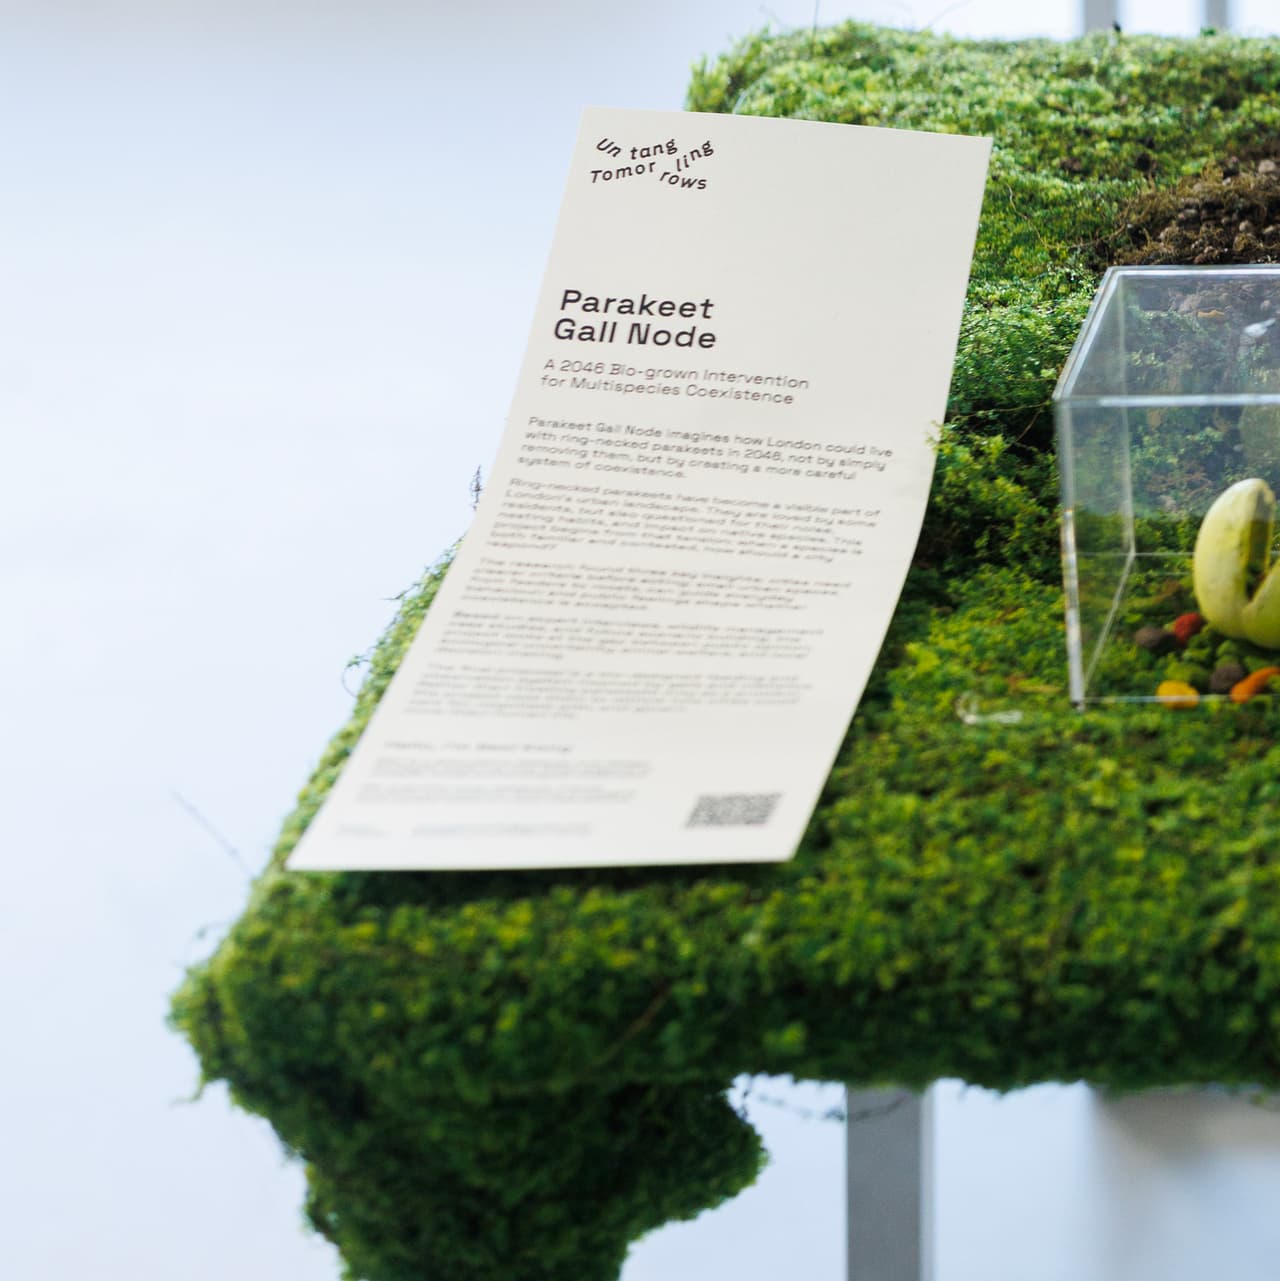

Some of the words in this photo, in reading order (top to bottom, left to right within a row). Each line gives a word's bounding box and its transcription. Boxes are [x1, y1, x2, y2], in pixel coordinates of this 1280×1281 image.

[597, 138, 621, 157] Un
[630, 139, 678, 160] tang
[676, 140, 714, 172] ling
[590, 162, 656, 183] Tomor
[660, 171, 707, 190] rows
[560, 289, 714, 319] Parakeet
[554, 318, 617, 343] Gall
[627, 322, 716, 348] Node
[544, 358, 555, 371] A
[560, 360, 604, 374] 2046
[609, 363, 699, 380] Bio-grown
[703, 369, 809, 390] Intervention
[541, 375, 566, 387] for
[570, 376, 680, 396] Multispecies
[686, 384, 794, 405] Coexistence
[525, 429, 557, 442] with
[561, 432, 649, 452] ring-necked
[653, 439, 725, 458] parakeets
[744, 446, 783, 461] 2046,
[788, 451, 814, 462] not
[840, 454, 887, 470] simply
[528, 417, 591, 432] Parakeet
[595, 422, 620, 435] Gall
[624, 425, 662, 438] Node
[667, 428, 730, 446] imagines
[734, 433, 763, 446] how
[766, 436, 822, 451] London
[825, 441, 866, 454] could
[870, 444, 893, 456] live
[517, 455, 571, 471] system
[594, 460, 687, 478] coexistence.
[521, 441, 589, 460] removing
[592, 447, 634, 462] them,
[637, 451, 662, 463] but
[689, 455, 750, 473] creating
[766, 464, 802, 475] more
[806, 465, 856, 479] careful
